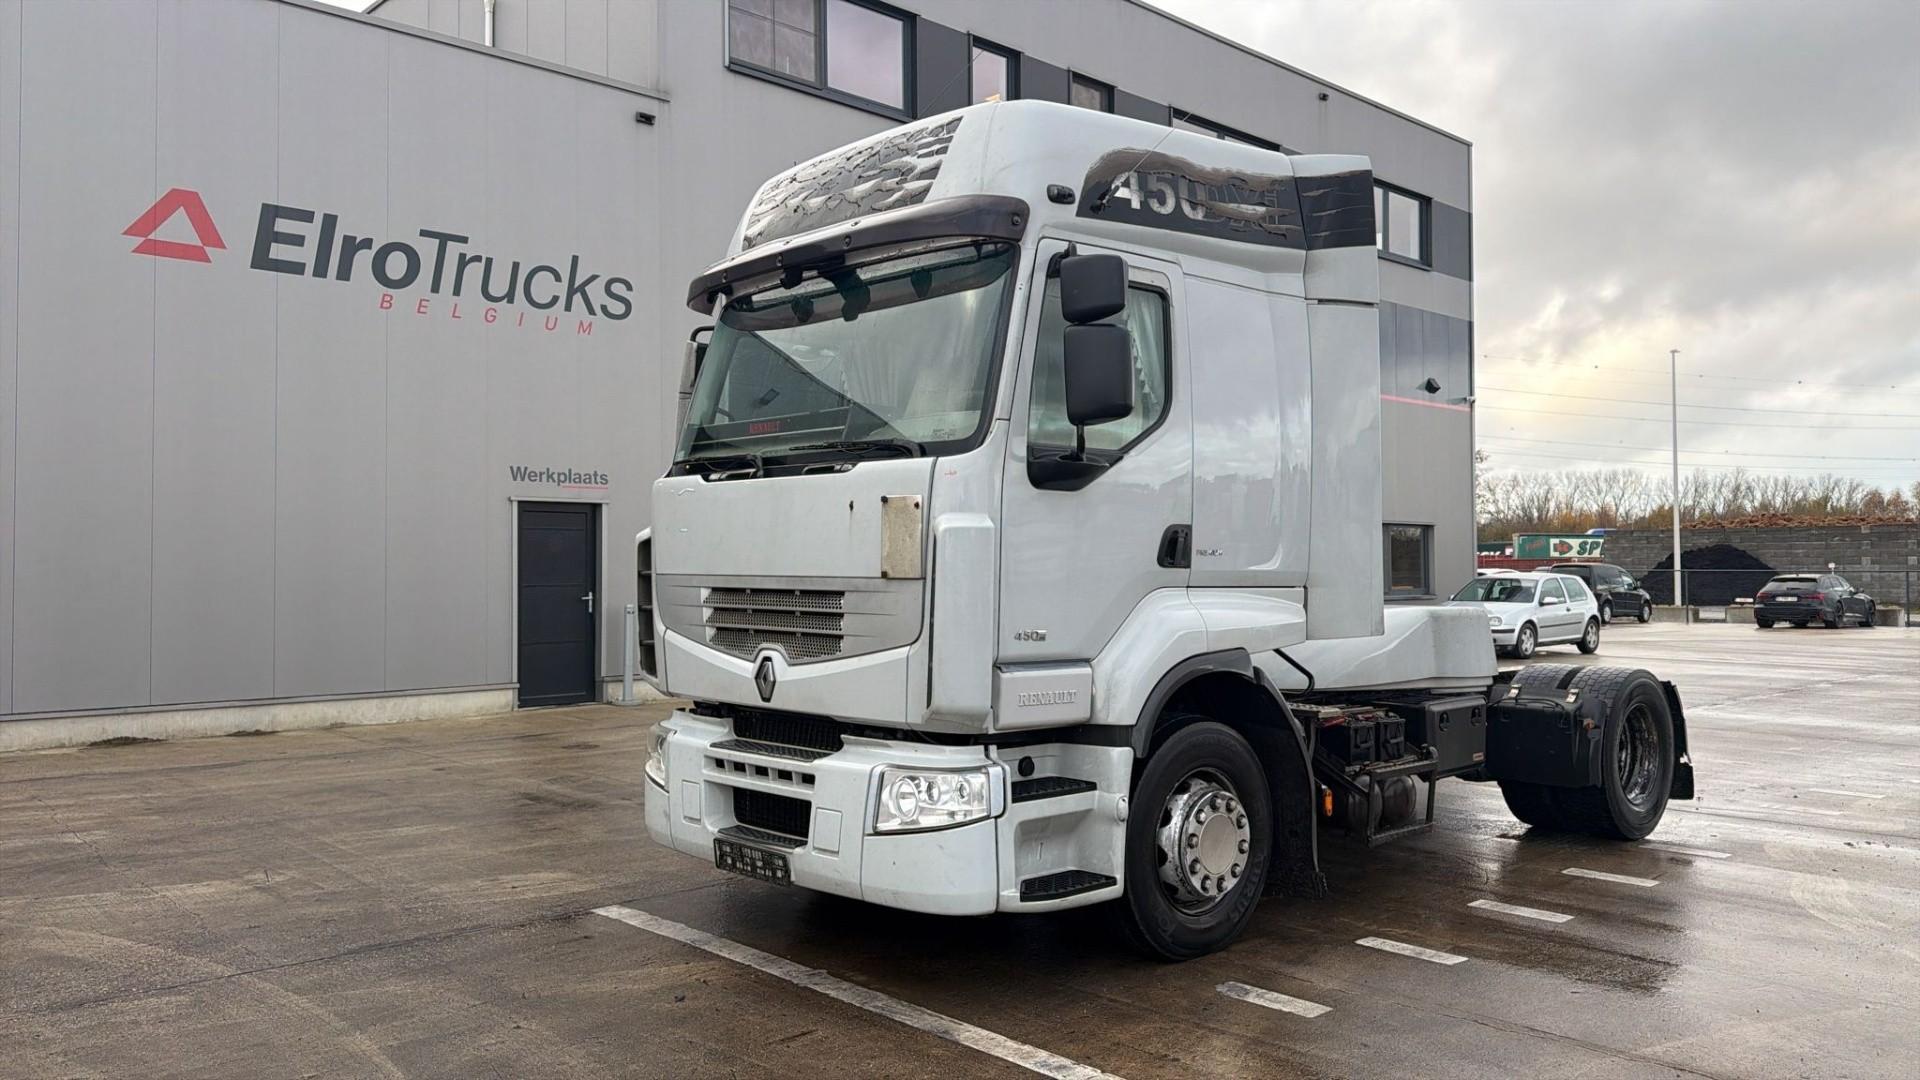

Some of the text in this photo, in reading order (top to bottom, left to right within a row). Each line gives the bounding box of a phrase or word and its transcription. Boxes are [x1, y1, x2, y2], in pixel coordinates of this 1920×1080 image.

[249, 202, 634, 321] ElroTrucks
[379, 293, 594, 336] BELGIUM
[509, 465, 609, 487] Werkplaats
[1576, 540, 1605, 557] SP
[1017, 689, 1078, 707] RENAULT
